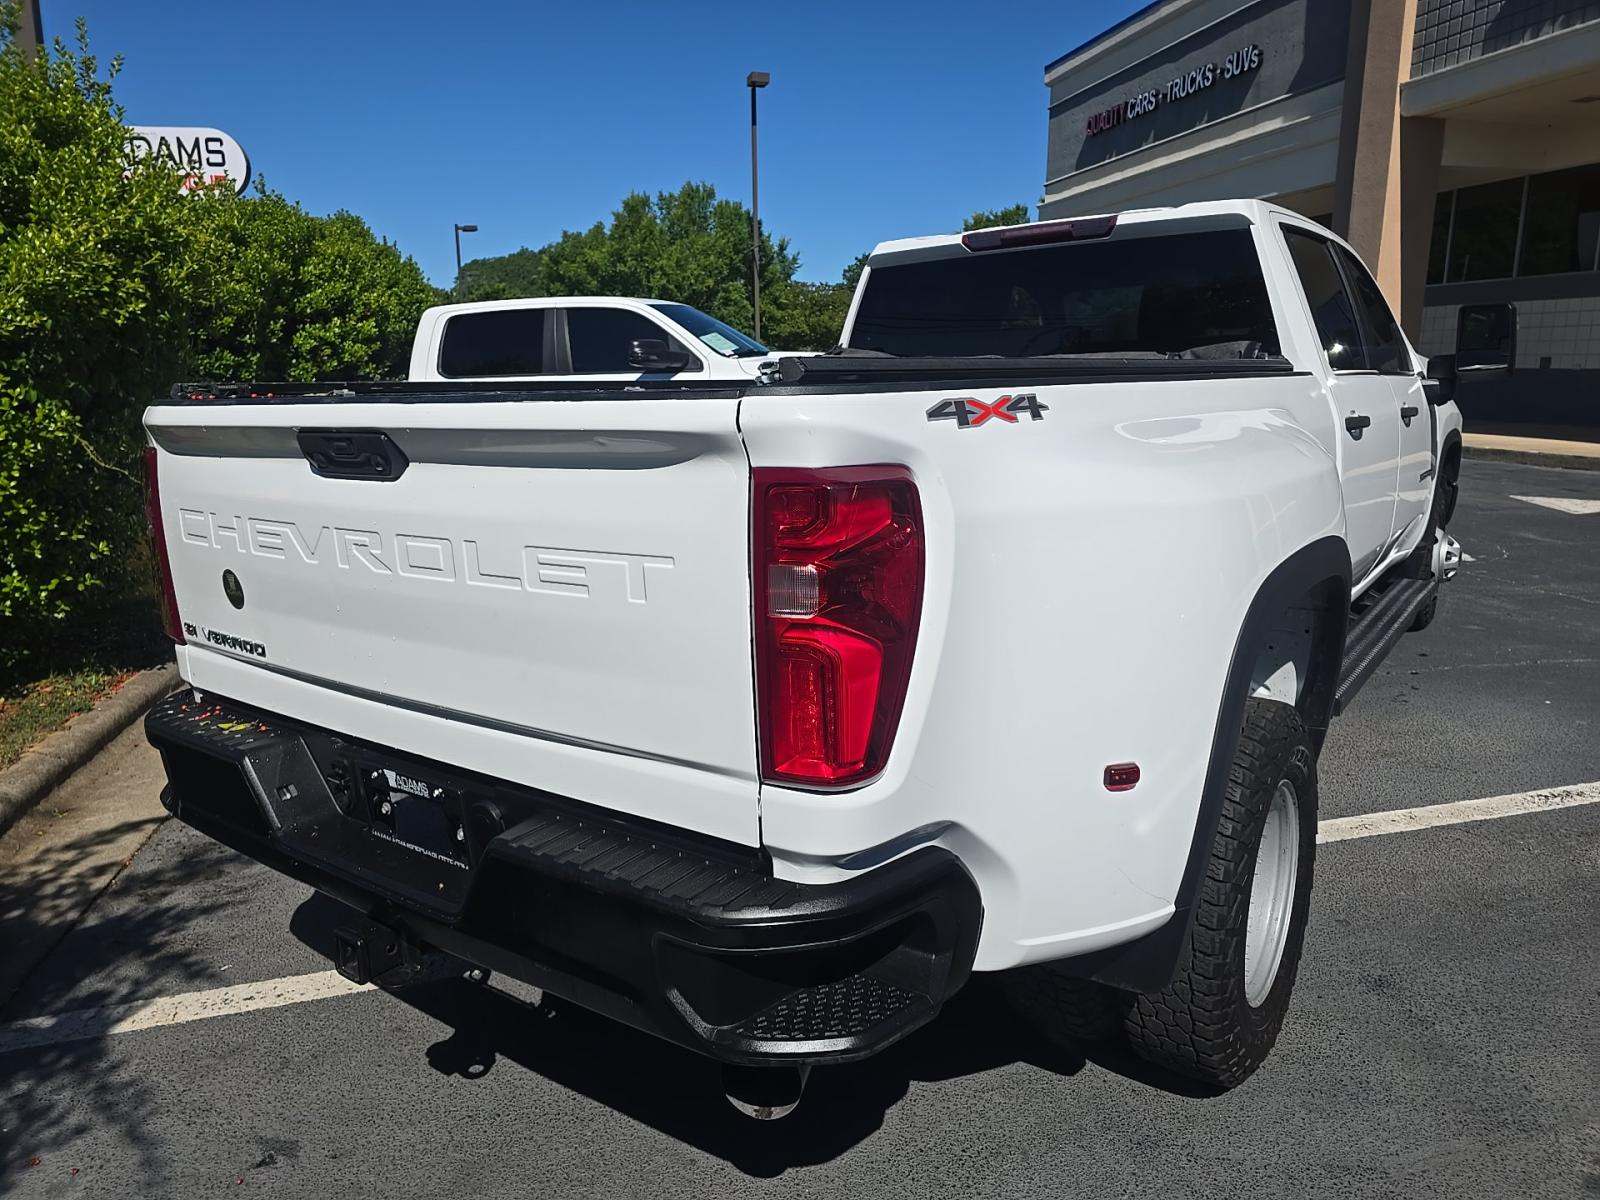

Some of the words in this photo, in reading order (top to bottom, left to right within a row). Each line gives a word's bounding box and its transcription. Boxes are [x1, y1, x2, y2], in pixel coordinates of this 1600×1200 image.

[1086, 103, 1127, 136] QUALITY
[1127, 89, 1156, 119] CARS
[1165, 63, 1213, 103] TRUCKS
[1224, 45, 1259, 79] SUVs
[121, 136, 226, 168] DAMS
[180, 508, 675, 603] CHEVROLET
[396, 775, 428, 794] ADAMS
